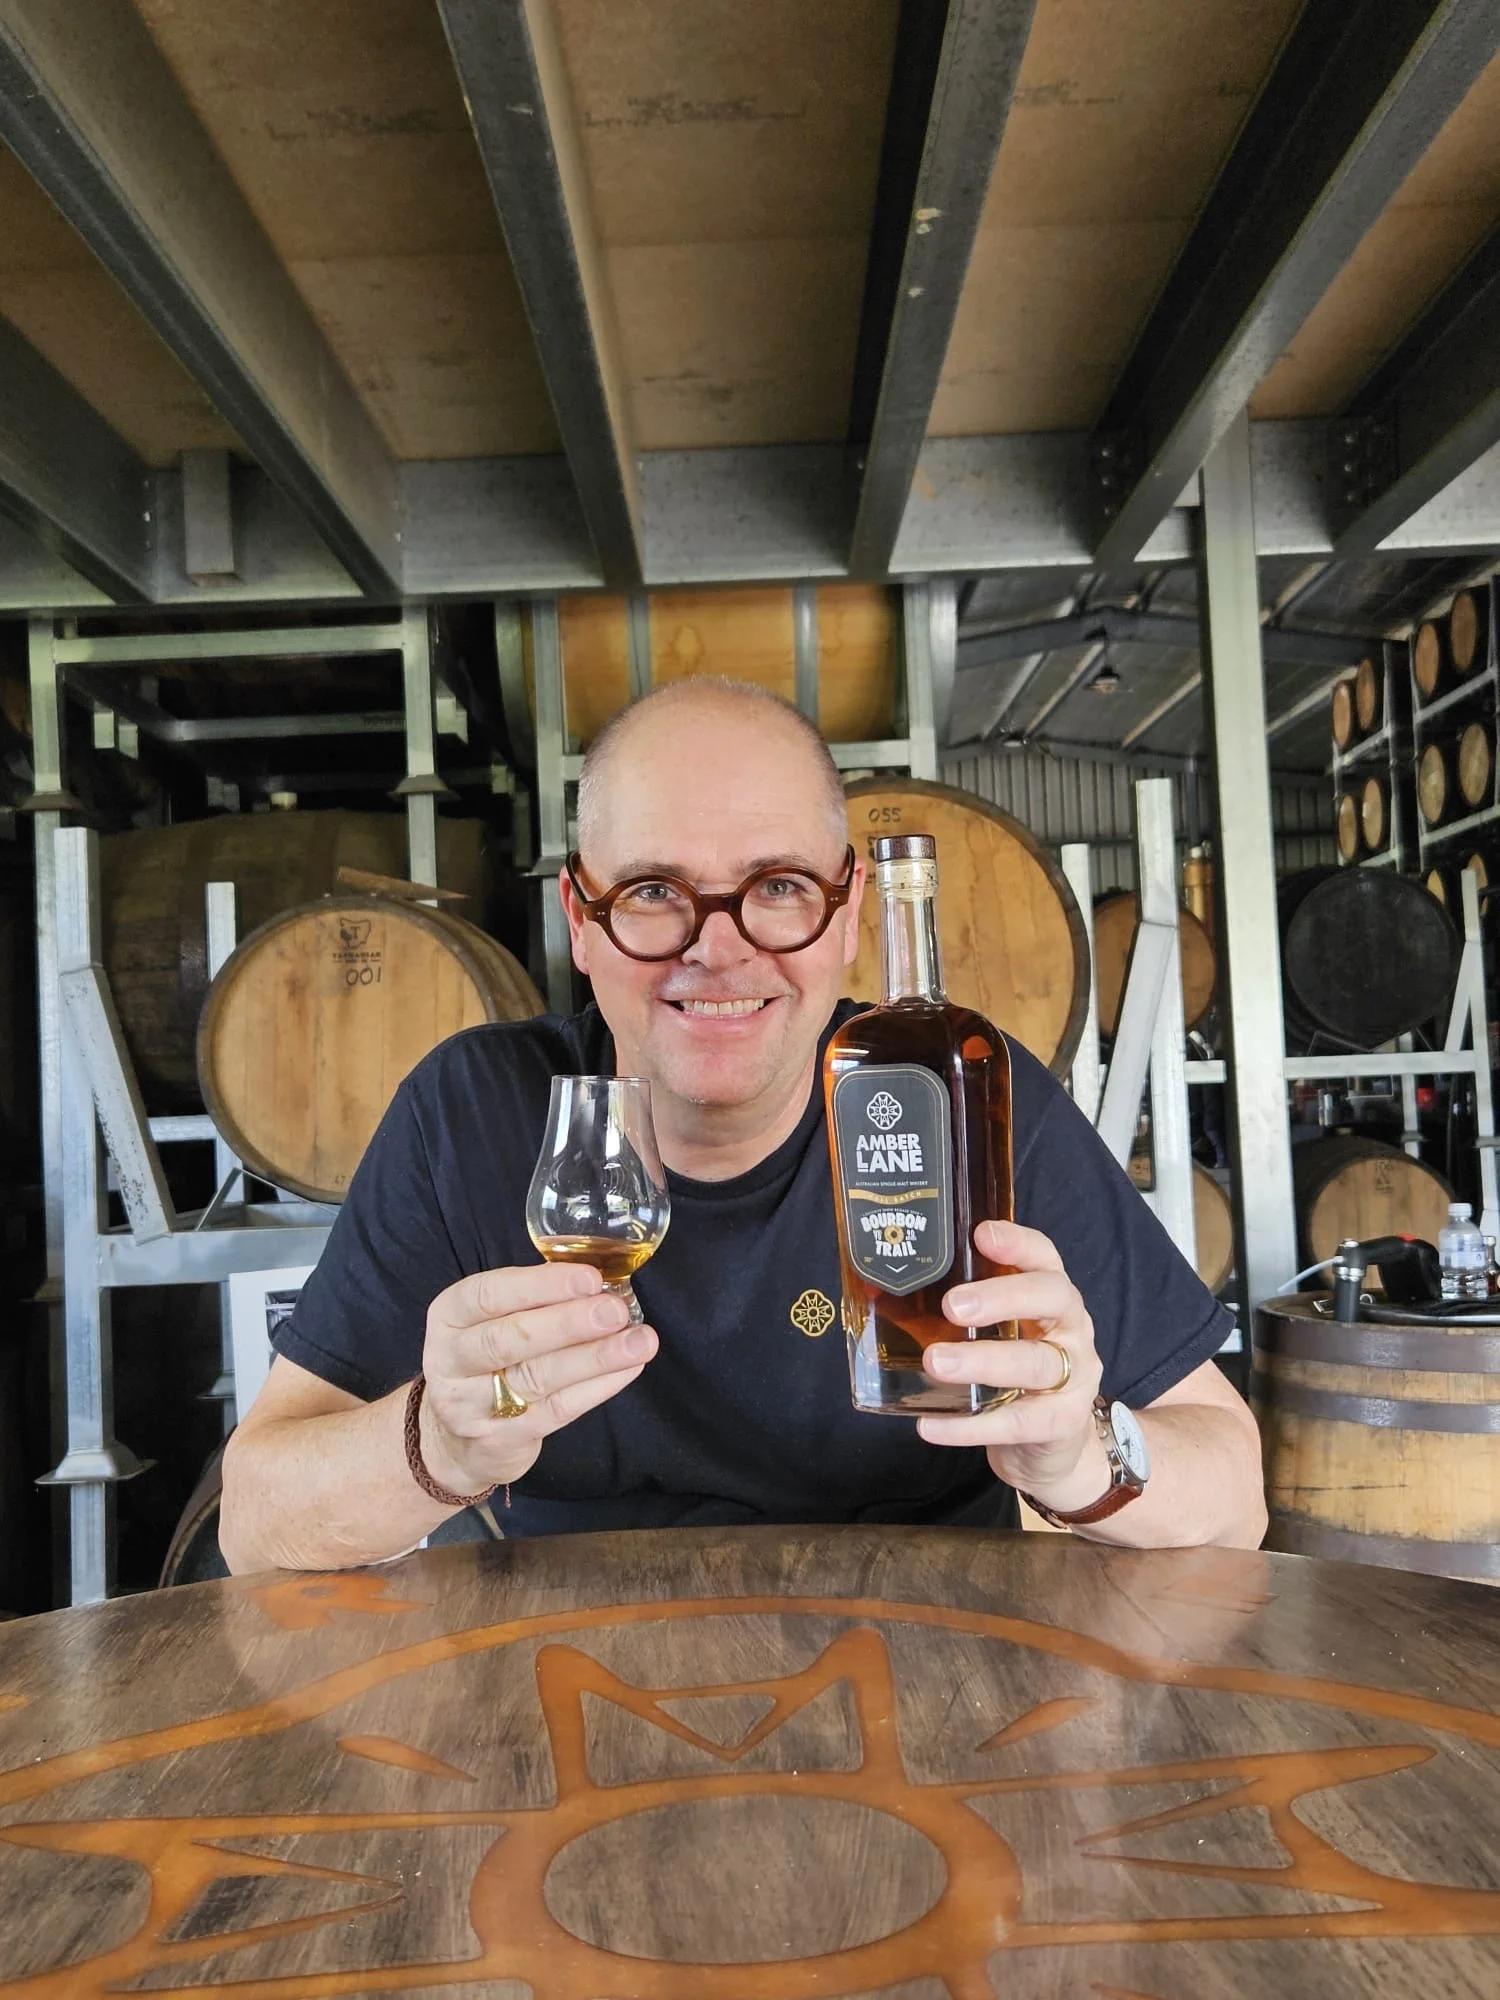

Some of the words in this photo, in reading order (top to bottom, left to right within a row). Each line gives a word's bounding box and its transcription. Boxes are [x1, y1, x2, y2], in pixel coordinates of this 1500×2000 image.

[346, 966, 382, 986] 001
[856, 1134, 921, 1150] AMBER
[856, 1150, 924, 1173] LANE
[893, 1191, 922, 1203] BATCH
[860, 1212, 928, 1233] BOURBON
[875, 1240, 917, 1257] TRAIL
